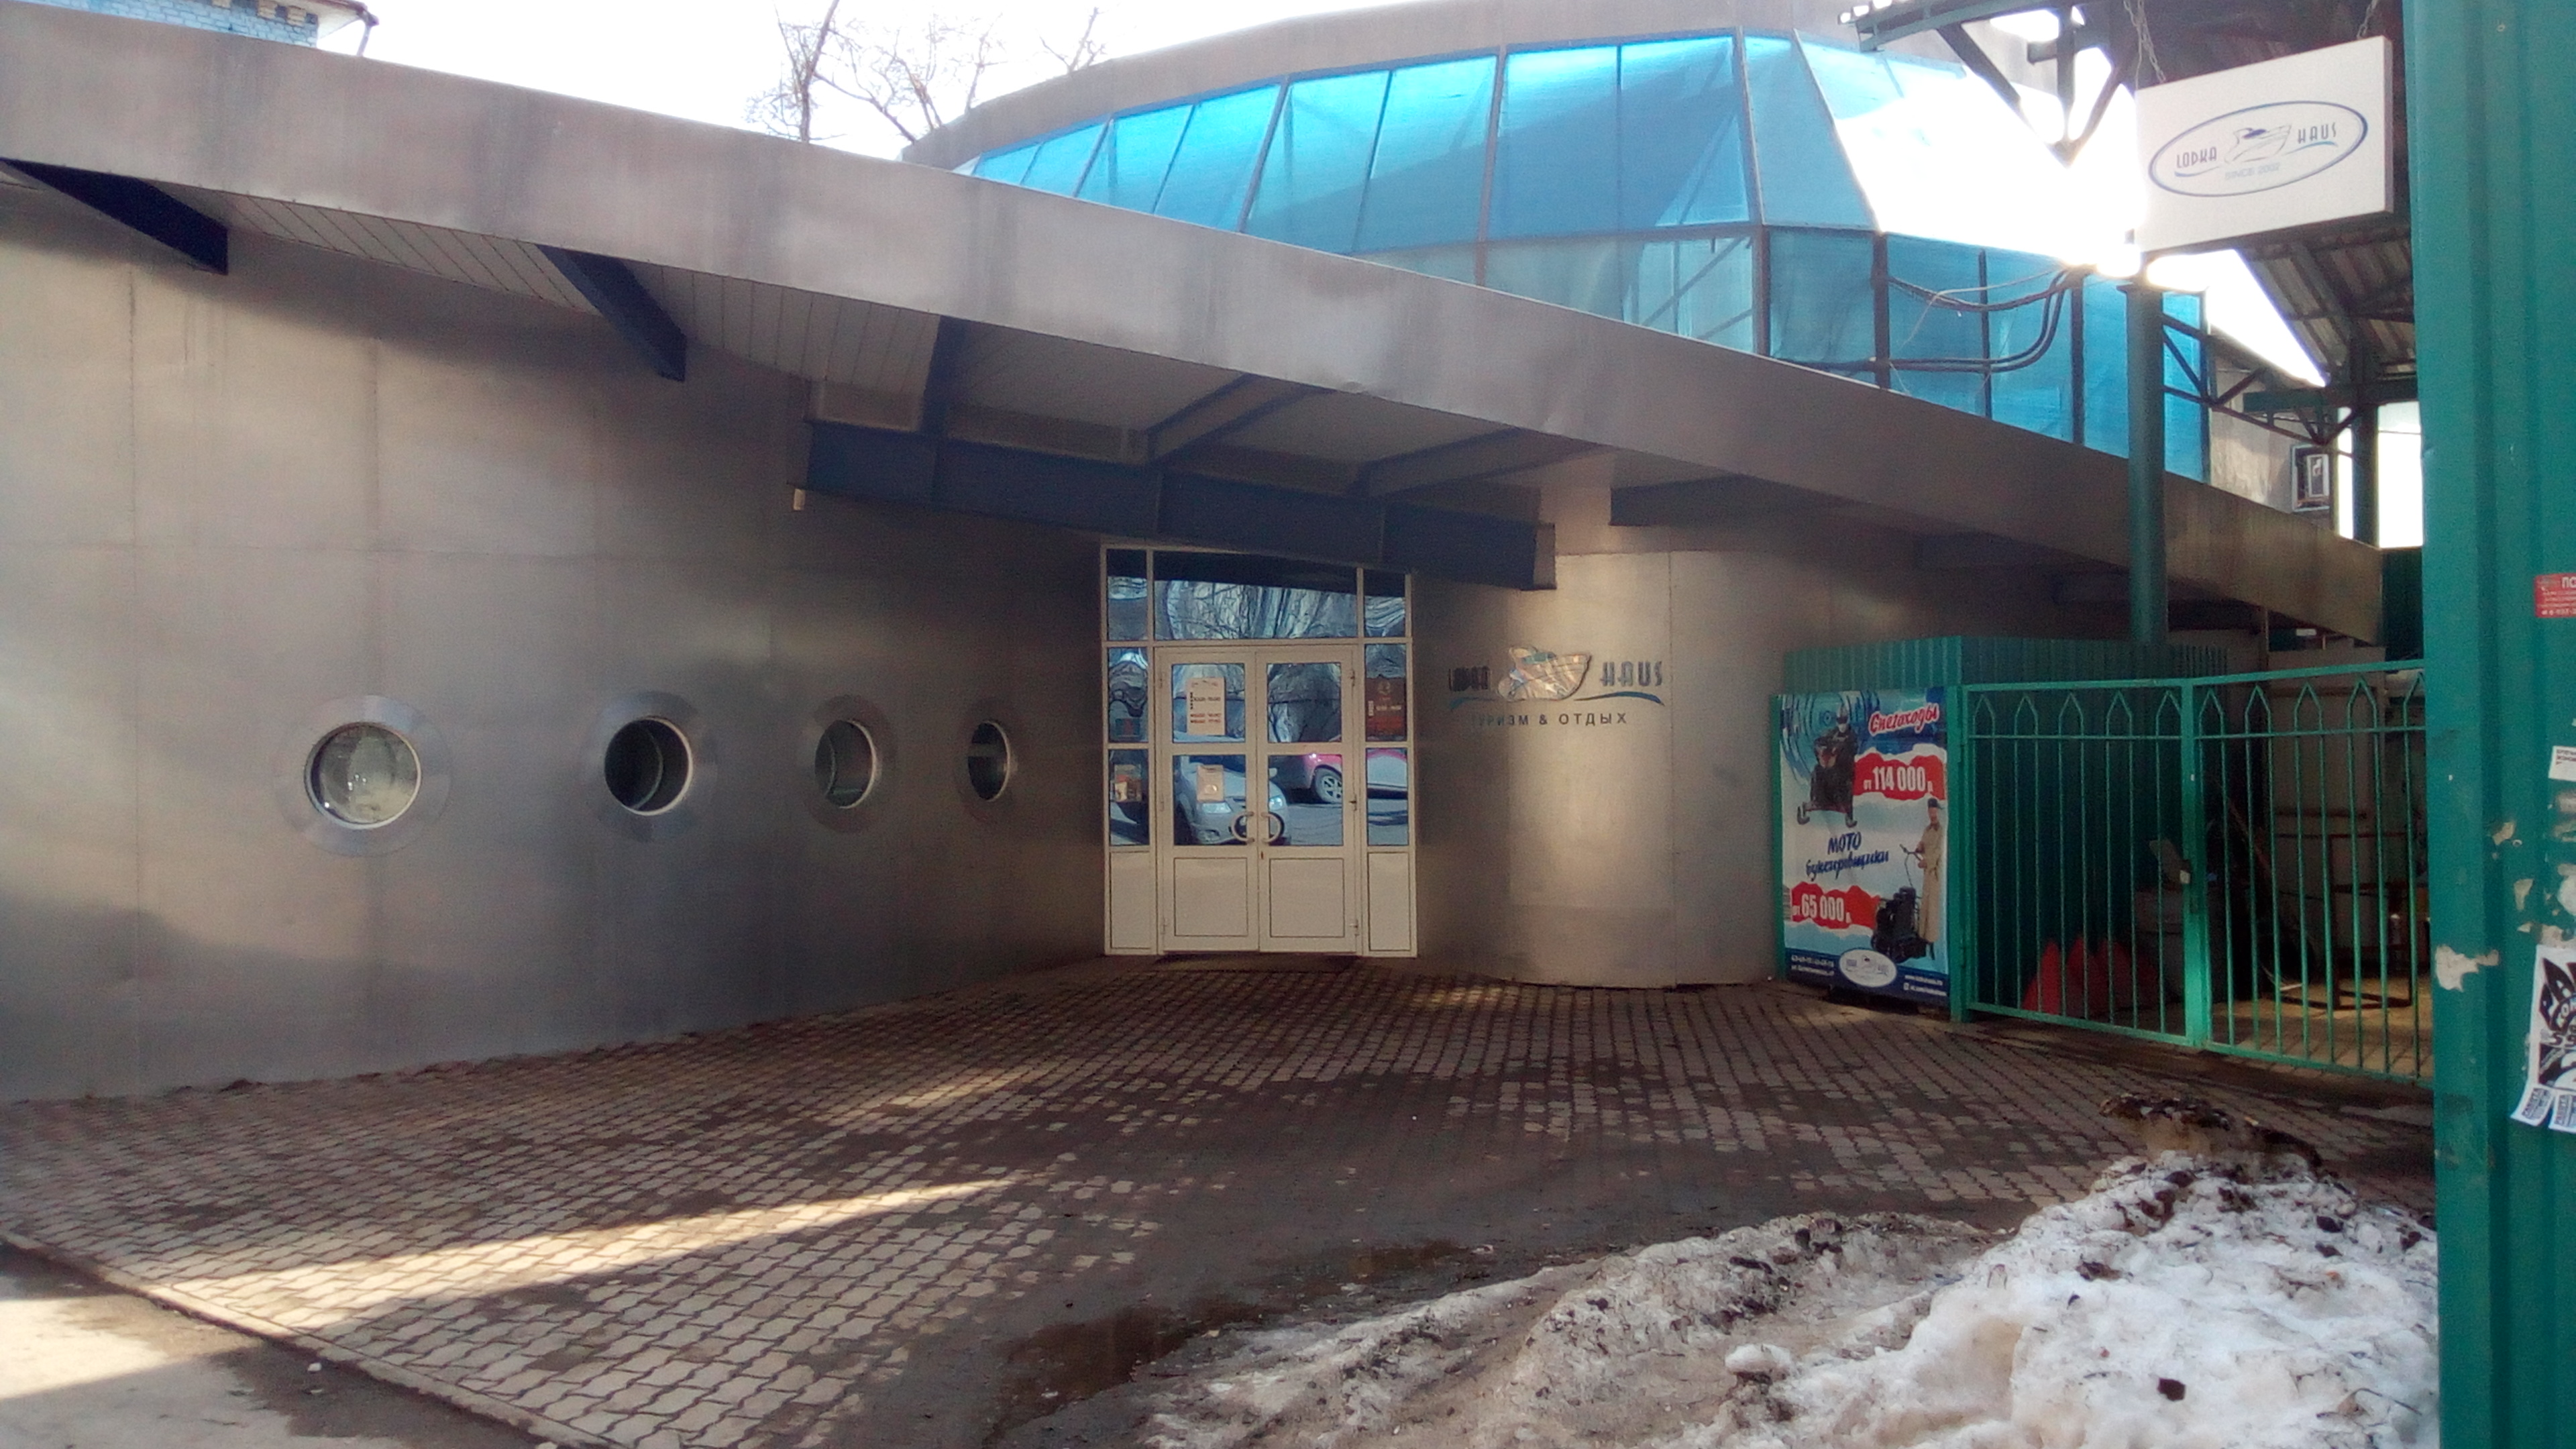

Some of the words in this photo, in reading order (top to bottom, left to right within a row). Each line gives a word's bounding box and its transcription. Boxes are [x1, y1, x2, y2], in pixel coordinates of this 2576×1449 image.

[2176, 146, 2217, 168] LODKA
[2298, 122, 2337, 144] HAUS
[1600, 661, 1662, 686] HAUS
[1539, 714, 1548, 725] &
[1558, 712, 1627, 726] ОТДЫХ
[1869, 703, 1939, 735] Снегоходы
[1872, 765, 1894, 791] 114
[1896, 766, 1926, 792] 000
[1827, 831, 1862, 855] МОТО
[1801, 893, 1817, 918] 65
[1819, 895, 1845, 922] 000
